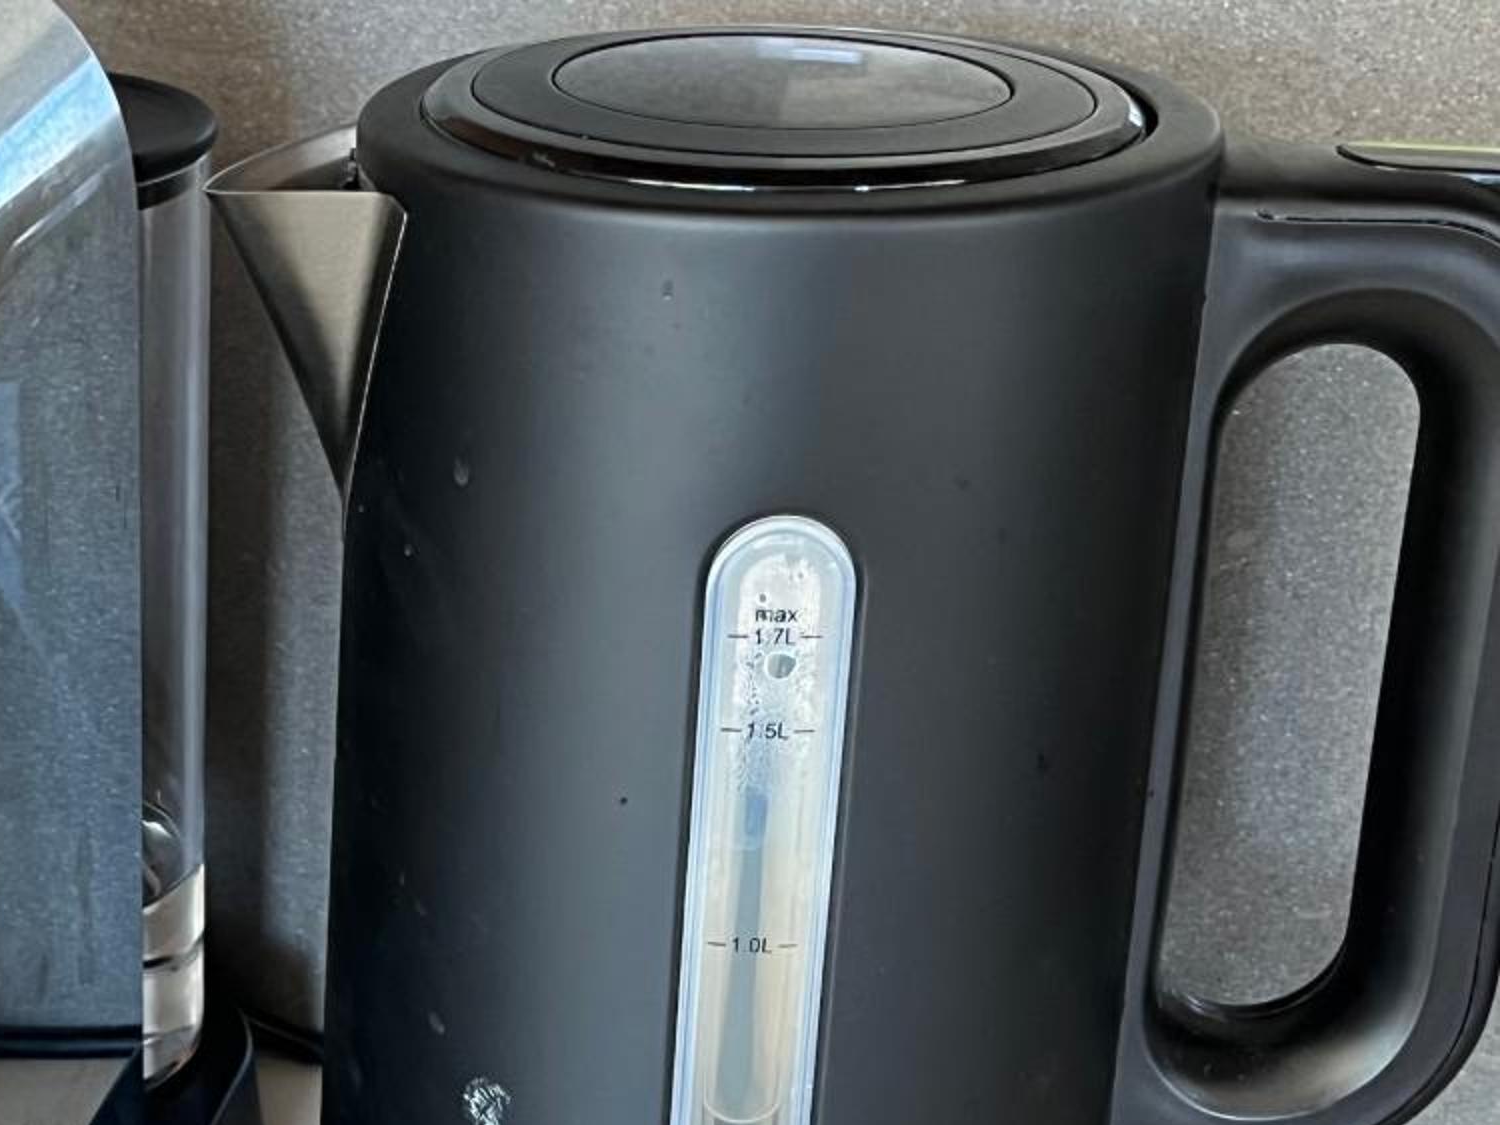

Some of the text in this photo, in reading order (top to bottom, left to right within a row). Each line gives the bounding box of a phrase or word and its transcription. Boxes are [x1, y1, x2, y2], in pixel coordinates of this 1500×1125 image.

[755, 608, 797, 622] max
[754, 628, 795, 645] 17L
[731, 937, 772, 954] 10L
